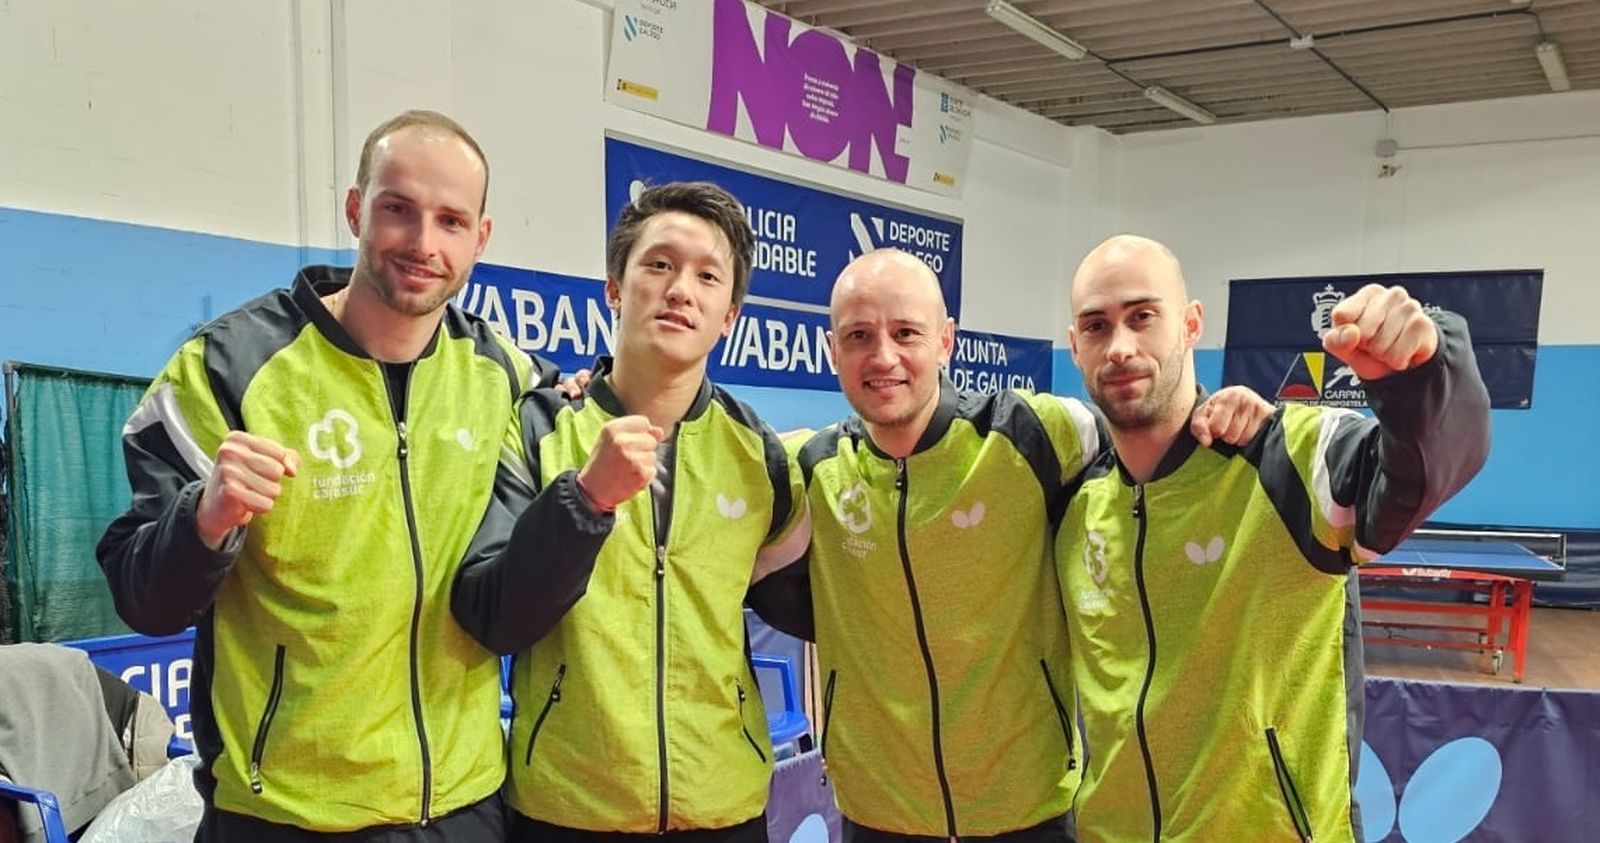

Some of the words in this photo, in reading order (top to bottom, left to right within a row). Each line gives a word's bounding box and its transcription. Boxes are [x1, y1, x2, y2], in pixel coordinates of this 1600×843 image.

[747, 206, 796, 243] LICIA
[889, 221, 951, 252] DEPORTE
[955, 337, 1009, 367] XUNTA
[953, 368, 976, 393] DE
[977, 370, 1036, 397] GALICIA
